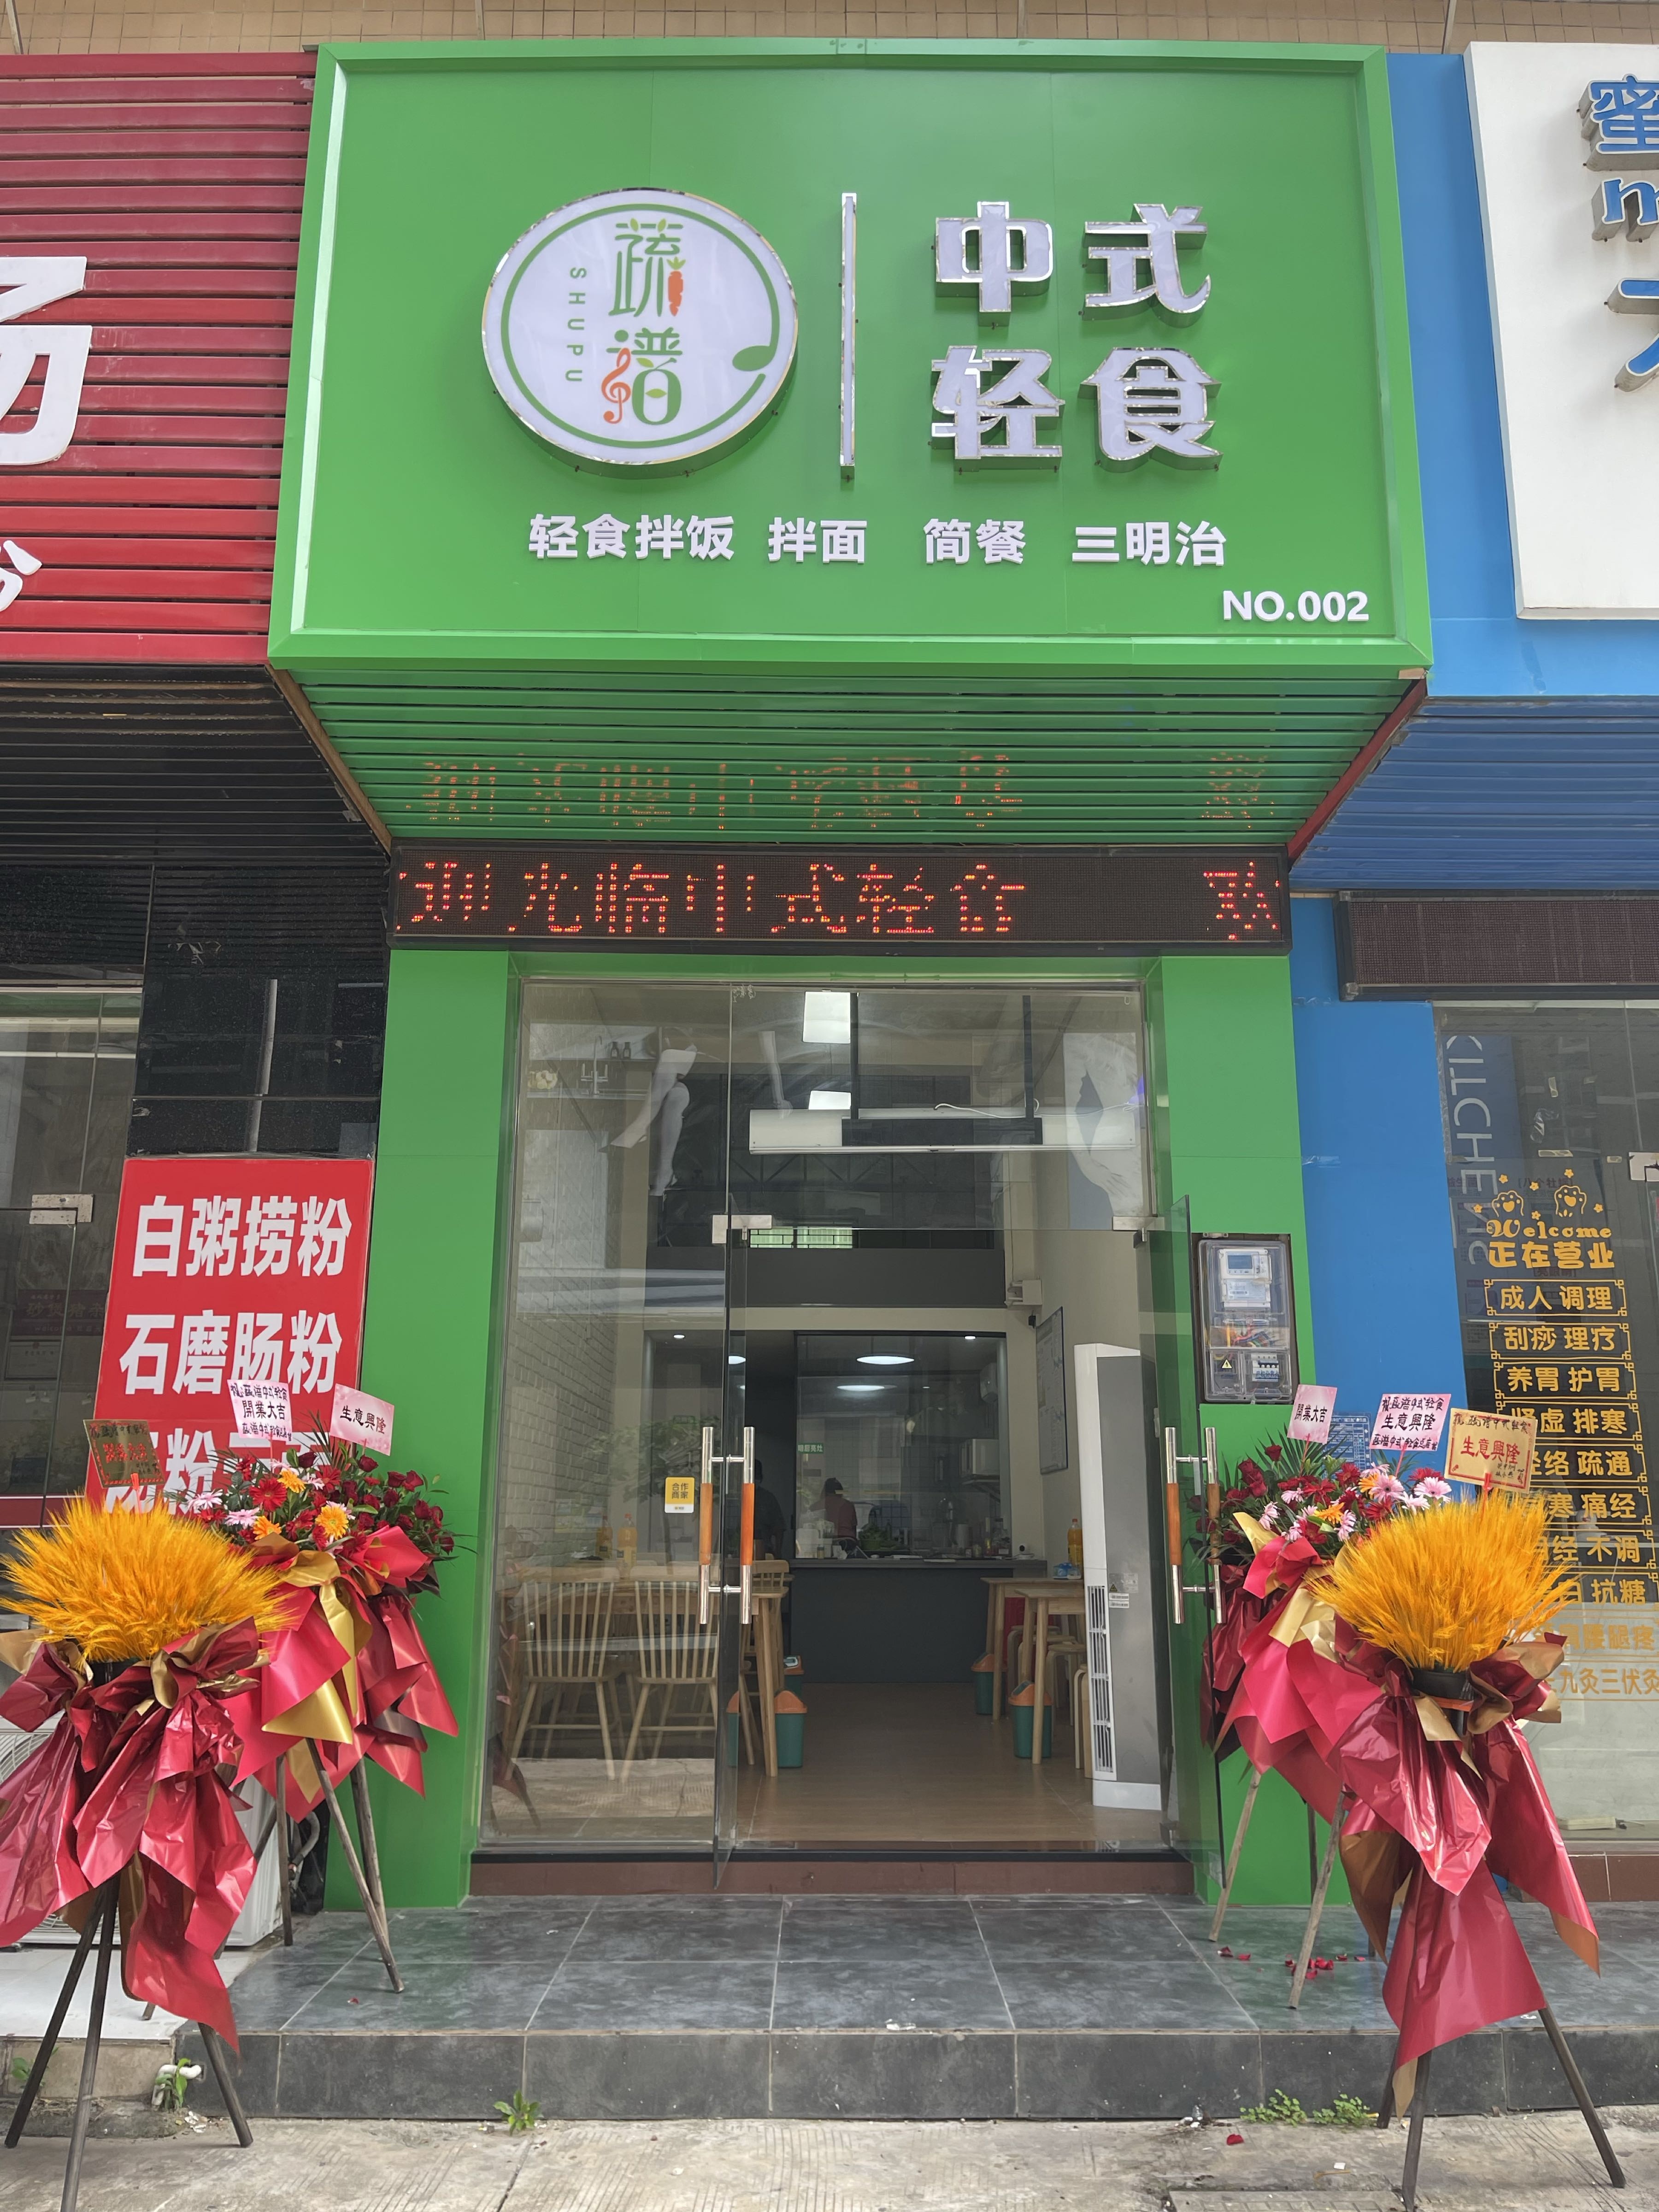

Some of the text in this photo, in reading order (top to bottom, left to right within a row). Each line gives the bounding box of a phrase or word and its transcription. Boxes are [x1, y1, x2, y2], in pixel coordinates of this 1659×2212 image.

[935, 201, 1212, 314] 中式
[565, 267, 587, 382] SHUPU
[931, 345, 1224, 461] 轻食
[529, 513, 1227, 566] 轻食拌饭 拌面 简餐 三明治
[1223, 590, 1369, 622] NO.002
[133, 1195, 352, 1277] 白粥捞粉
[1486, 1218, 1612, 1239] Welcome
[1488, 1241, 1615, 1269] 正在营业
[1500, 1285, 1553, 1310] 成人
[1559, 1285, 1613, 1310] 调理
[119, 1309, 342, 1395] 石磨肠粉
[1504, 1325, 1557, 1351] 刮痧
[1564, 1325, 1616, 1351] 理疗
[1507, 1366, 1620, 1392] 养胃 护胃
[241, 1400, 286, 1420] 開業大吉
[340, 1405, 387, 1435] 生意興隆
[1294, 1403, 1328, 1423] 開業大吉
[1381, 1412, 1436, 1431] 生意興隆
[1572, 1408, 1628, 1435] 排寒
[1460, 1435, 1520, 1465] 生意興隆
[1577, 1450, 1633, 1476] 疏通
[671, 1483, 689, 1491] 合作
[1581, 1492, 1637, 1519] 痛经
[1587, 1535, 1641, 1563] 不调
[1591, 1578, 1646, 1606] 抗糖
